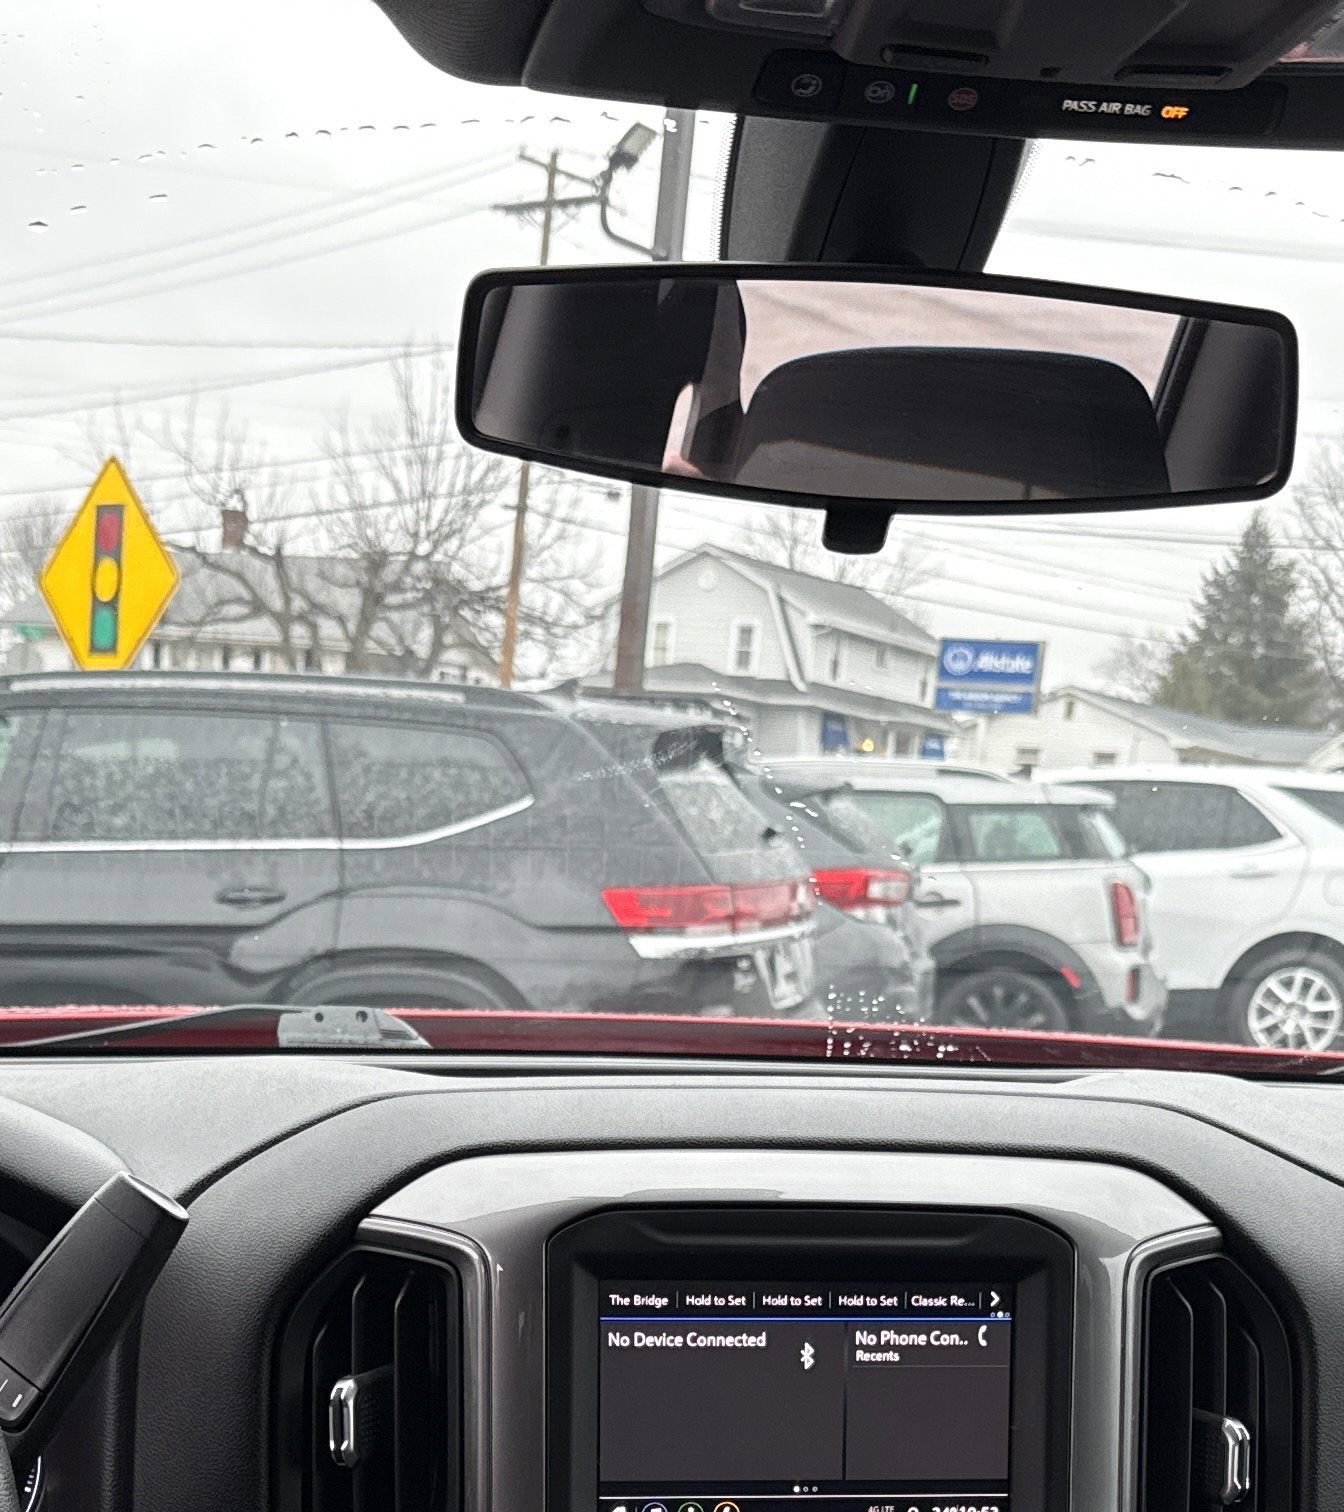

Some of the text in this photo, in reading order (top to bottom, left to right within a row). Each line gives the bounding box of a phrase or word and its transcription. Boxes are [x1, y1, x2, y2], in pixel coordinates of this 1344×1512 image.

[1061, 99, 1153, 117] PASS AIR BAG
[1160, 105, 1190, 119] OFF
[608, 1294, 669, 1309] The Bridge
[685, 1294, 747, 1306] Hold to Set
[762, 1294, 823, 1306] Hold to Set
[838, 1295, 898, 1307] Hold to Set
[910, 1295, 948, 1307] Classic
[607, 1330, 767, 1347] No Device Connected
[855, 1330, 877, 1346] No
[880, 1329, 928, 1346] Phone
[855, 1350, 900, 1362] Recents
